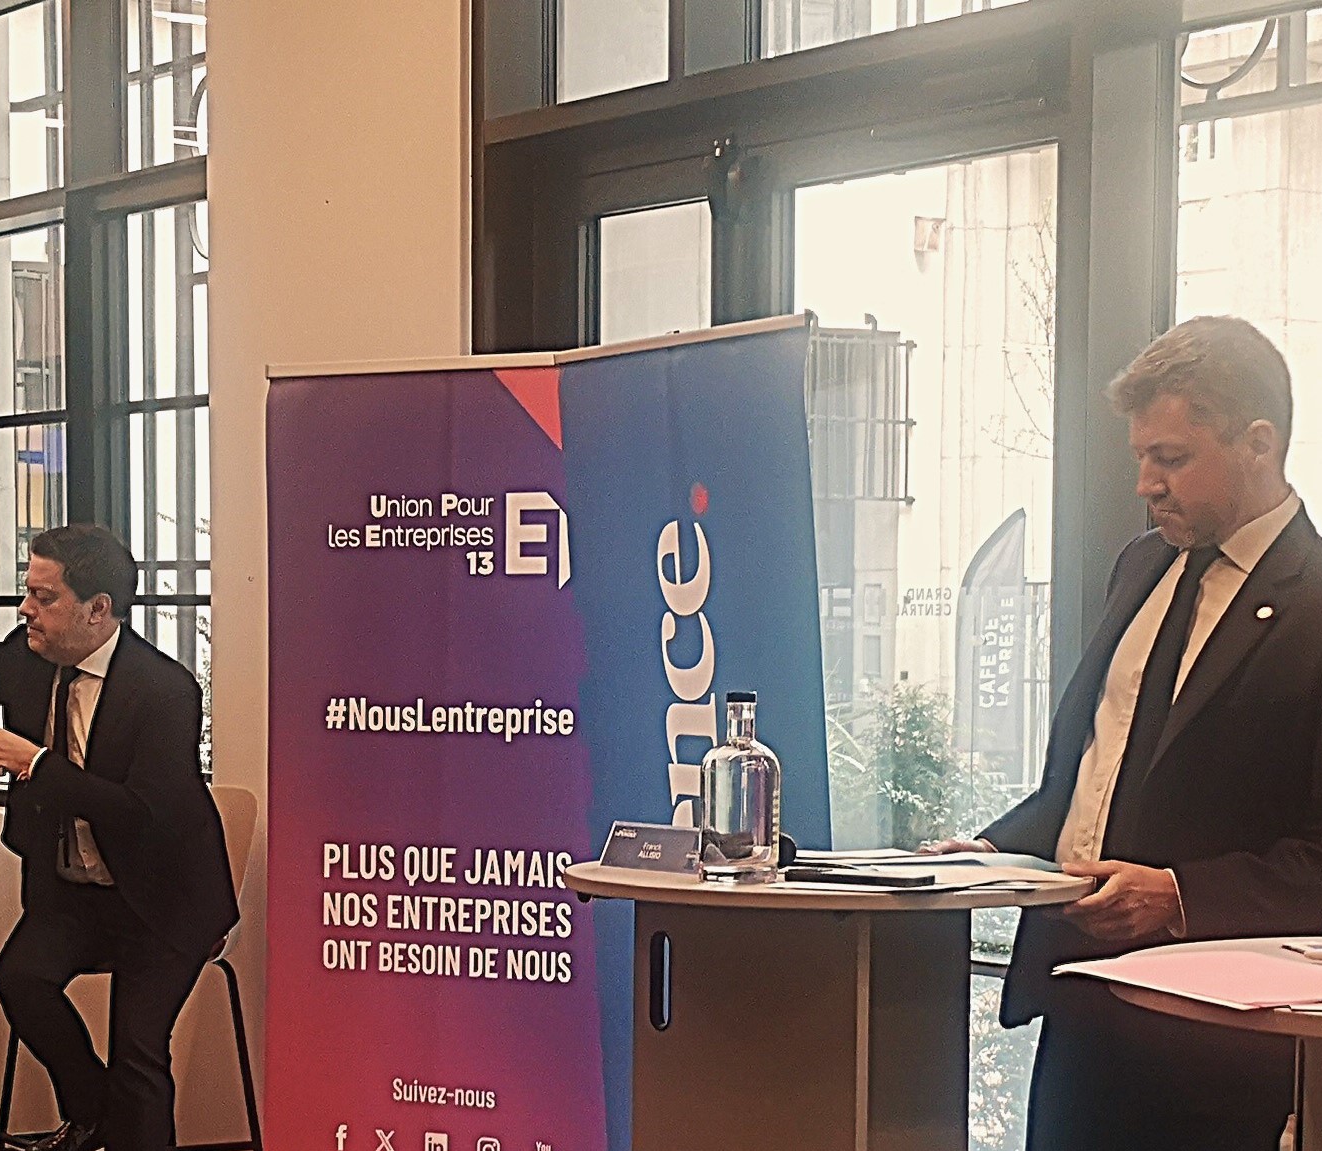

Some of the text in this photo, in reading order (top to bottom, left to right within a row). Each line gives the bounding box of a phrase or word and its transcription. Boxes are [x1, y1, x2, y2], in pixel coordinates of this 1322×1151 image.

[370, 492, 495, 518] Union Pour
[327, 523, 494, 552] les Entreprises
[466, 550, 495, 576] 13
[981, 617, 999, 646] DE
[996, 681, 1010, 707] LA
[325, 697, 575, 743] #NousLentreprise
[323, 843, 573, 889] PLUS QUE JAMAIS
[323, 891, 573, 939] NOS ENTREPRISES
[322, 939, 573, 984] ONT BESOIN DE NOUS
[392, 1077, 496, 1109] Suivez-nous
